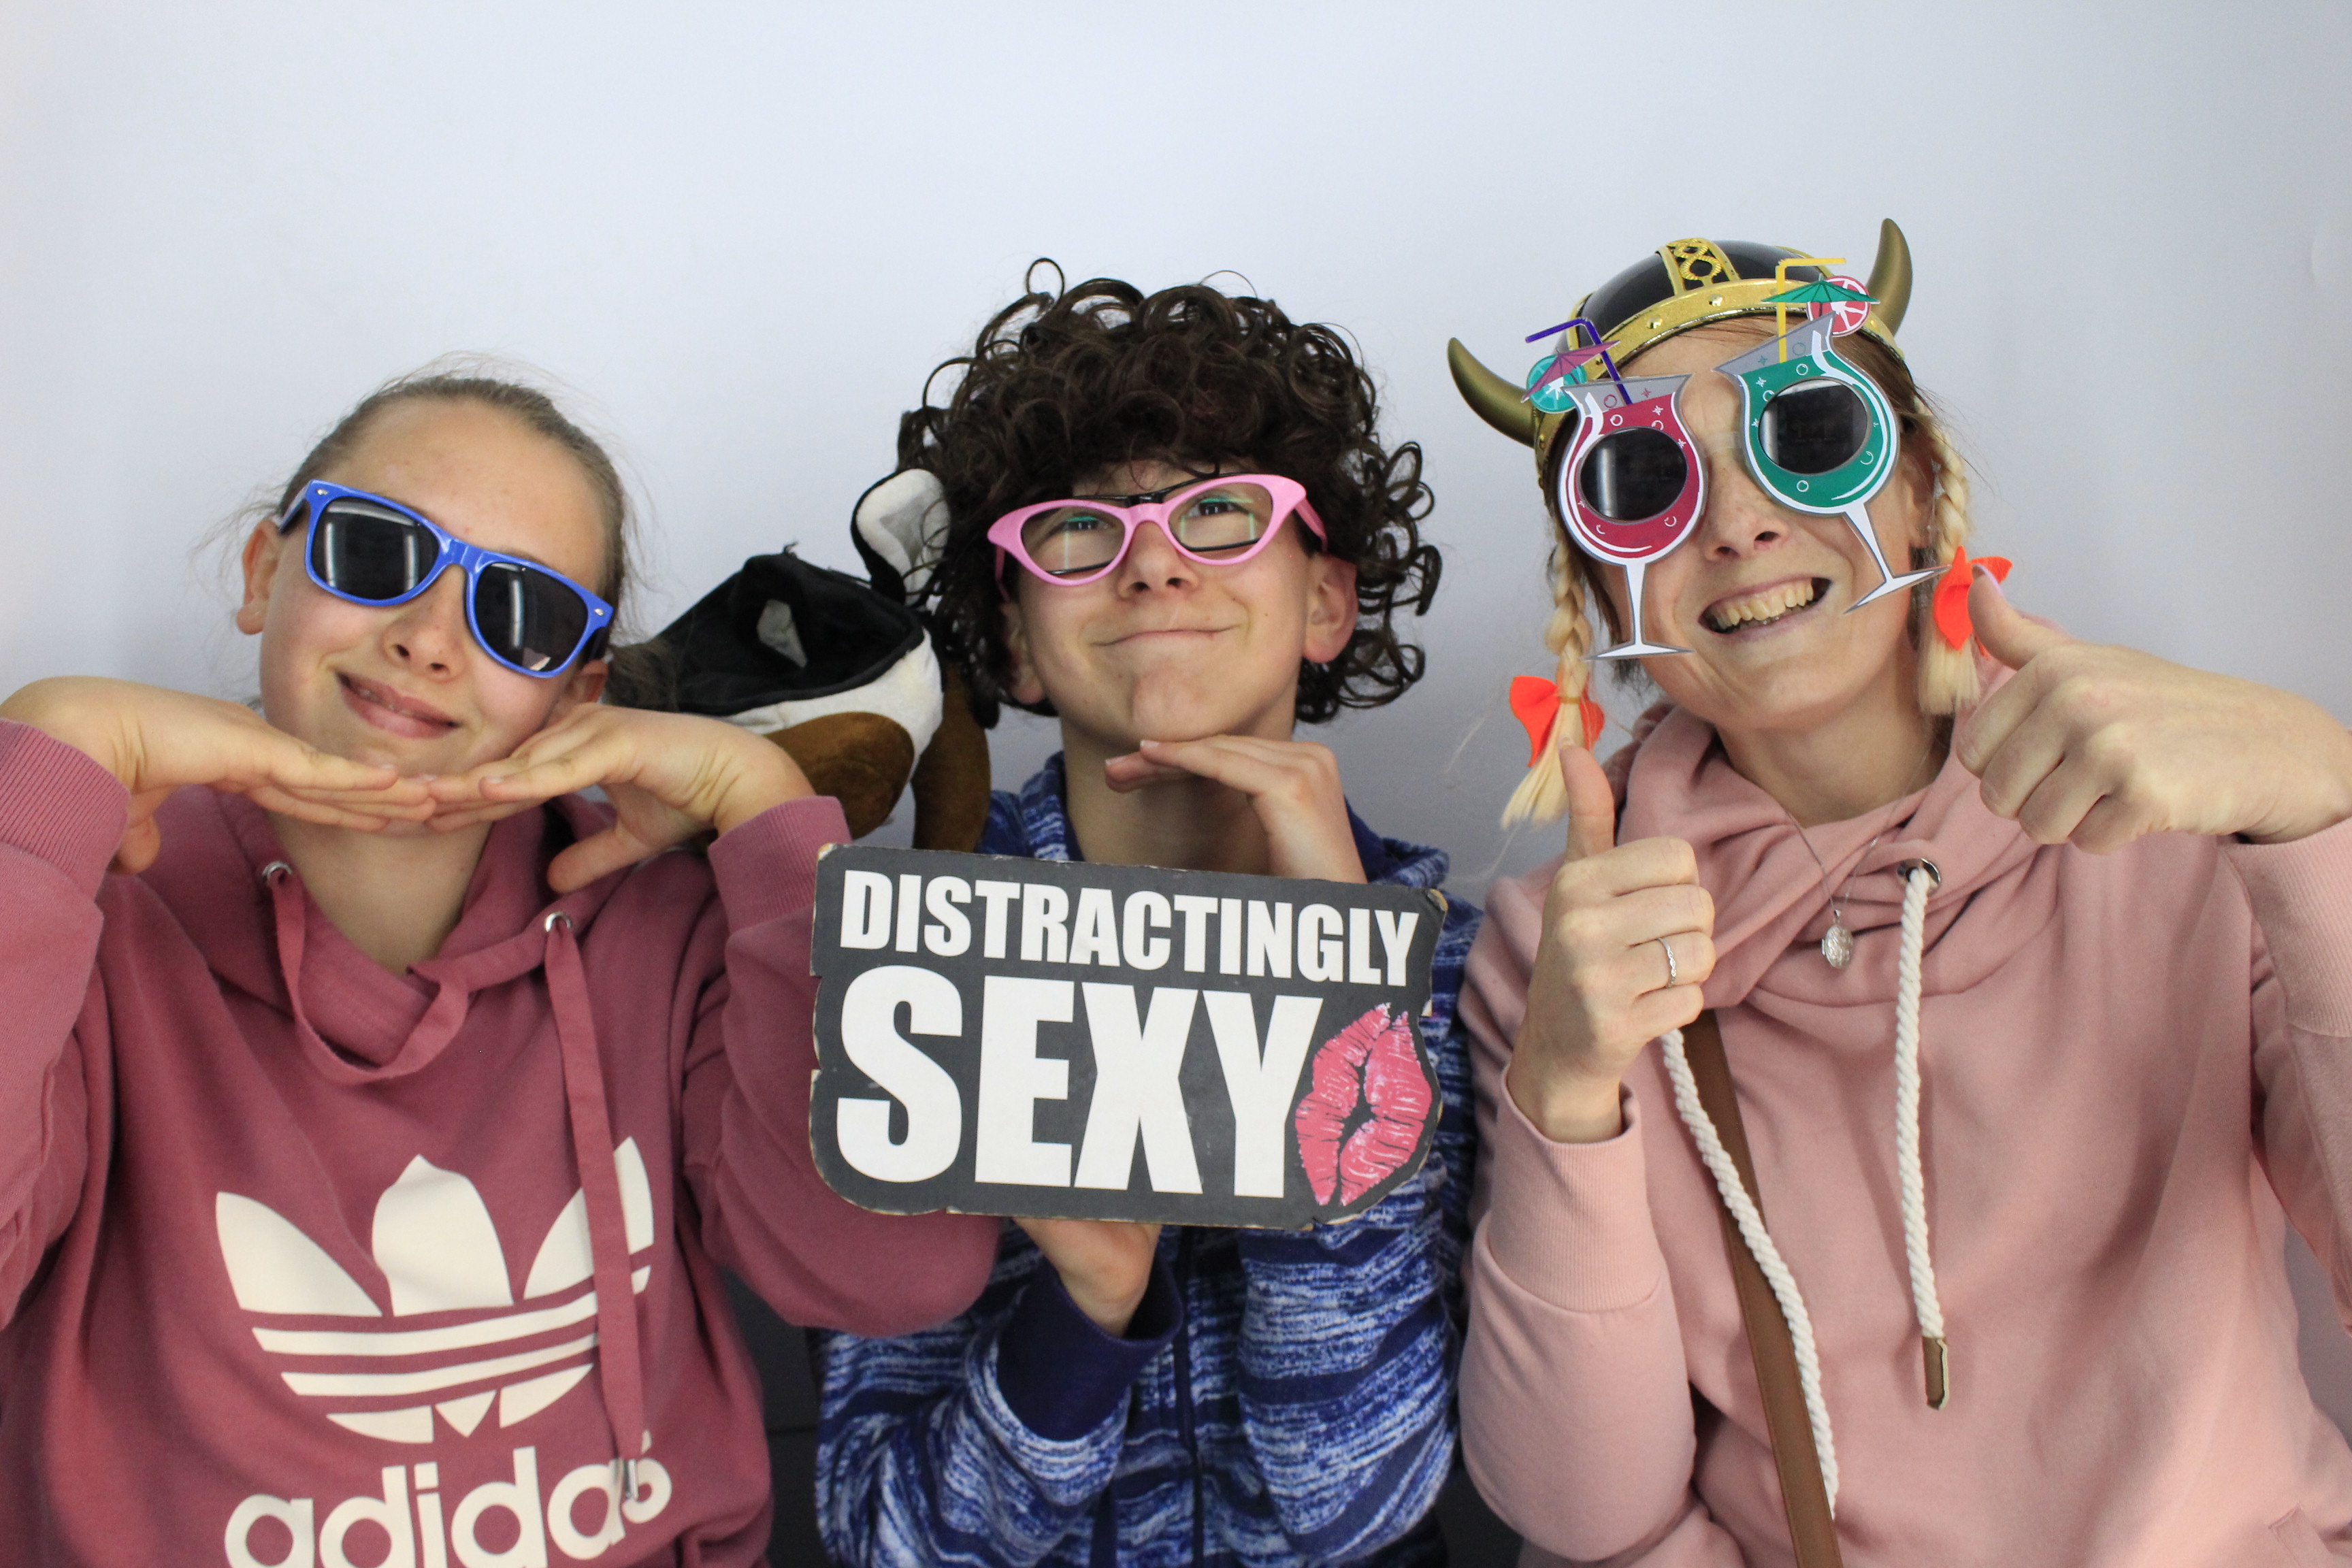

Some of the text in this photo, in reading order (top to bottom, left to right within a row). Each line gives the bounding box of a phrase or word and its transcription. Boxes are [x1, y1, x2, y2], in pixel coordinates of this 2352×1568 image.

[840, 870, 1419, 987] DISTRACTINGLY
[836, 965, 1323, 1198] SEXY
[224, 1429, 672, 1568] adidas
